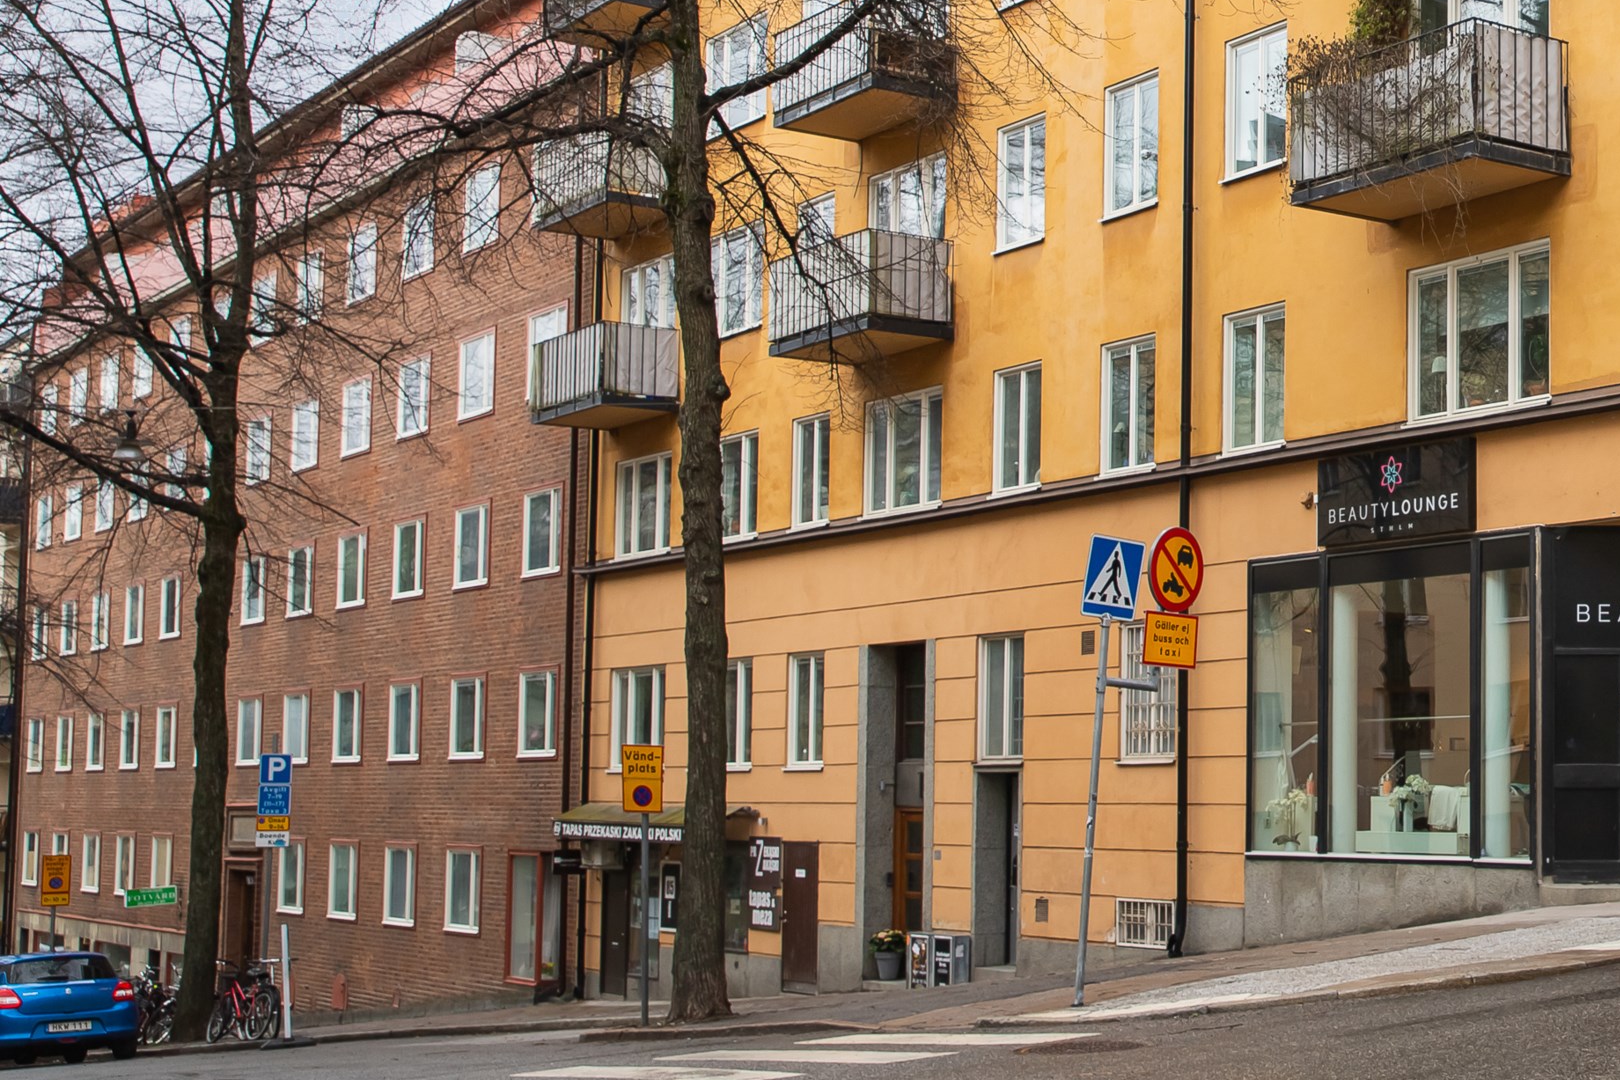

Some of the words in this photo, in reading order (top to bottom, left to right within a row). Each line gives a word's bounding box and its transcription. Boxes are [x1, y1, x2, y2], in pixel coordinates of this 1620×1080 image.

[1328, 492, 1459, 525] BEAUTYLOUNGE
[1370, 522, 1414, 534] STHLM
[1155, 620, 1180, 631] Gäller
[1181, 623, 1190, 634] ej
[1153, 633, 1172, 644] buss
[1175, 636, 1190, 645] och
[1159, 646, 1181, 657] taxi
[624, 750, 661, 761] Vänd-
[268, 757, 287, 782] P
[627, 763, 657, 774] plats
[562, 823, 583, 837] TAPAS
[655, 828, 682, 842] POLSKI
